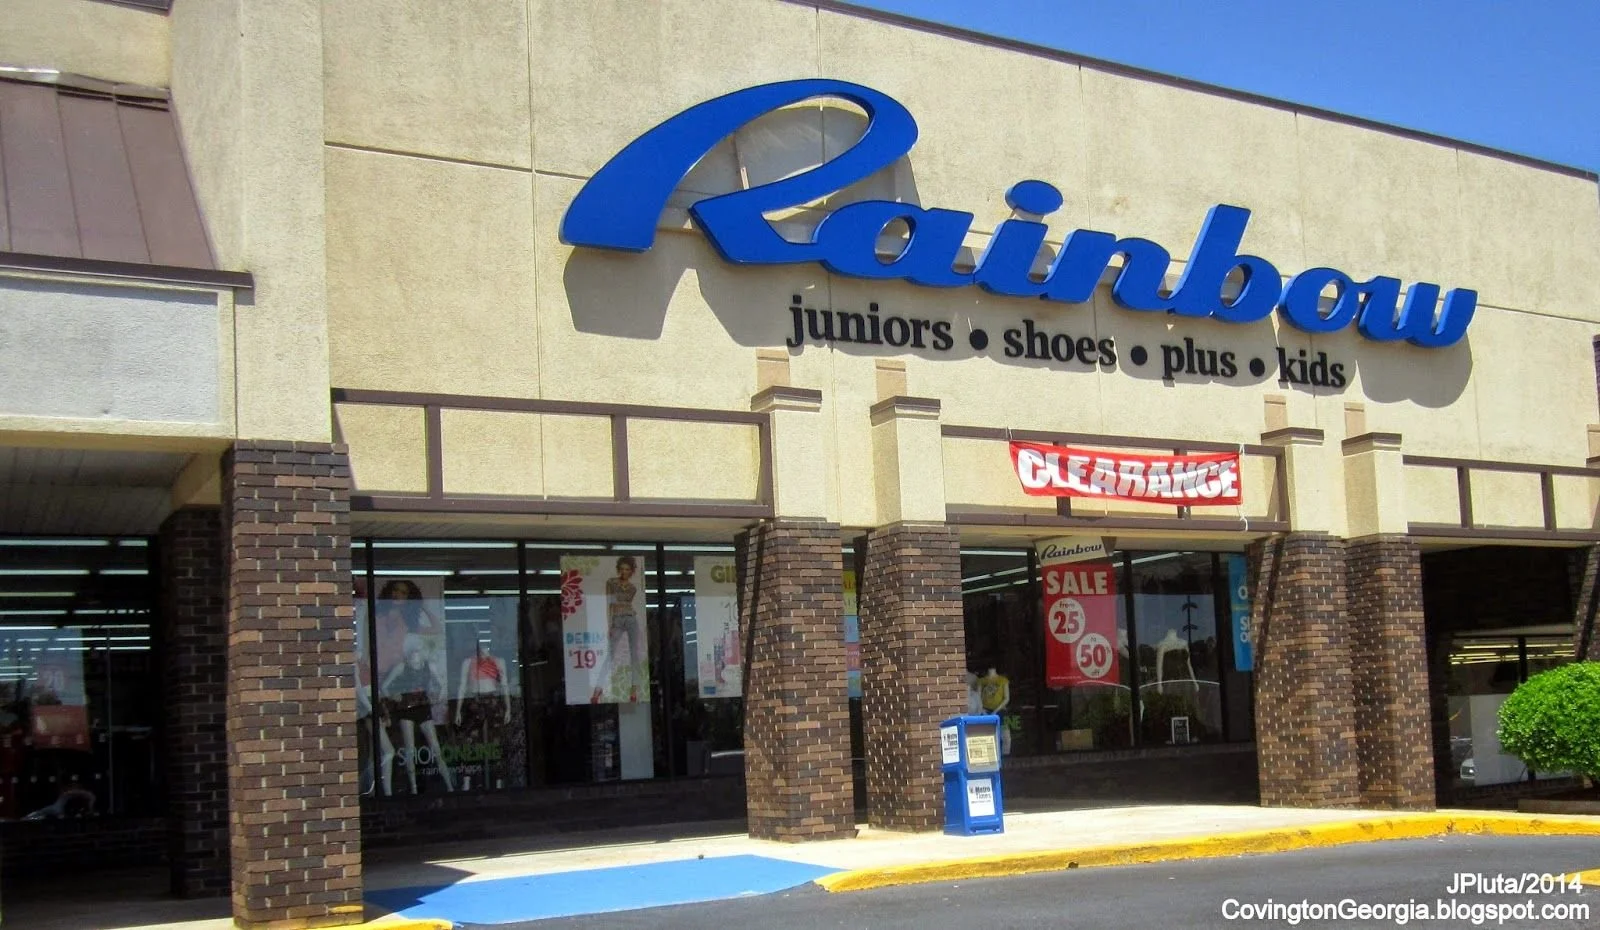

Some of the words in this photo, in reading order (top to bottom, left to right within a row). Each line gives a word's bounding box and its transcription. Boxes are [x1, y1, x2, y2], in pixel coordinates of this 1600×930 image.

[558, 78, 1478, 348] Rainbow
[786, 295, 953, 351] juniors
[1003, 319, 1117, 366] shoes
[1161, 337, 1238, 380] plus
[1276, 347, 1346, 388] kids
[1017, 448, 1240, 499] CLEARANCE
[1041, 543, 1102, 560] Rainbow
[1046, 571, 1108, 595] SALE
